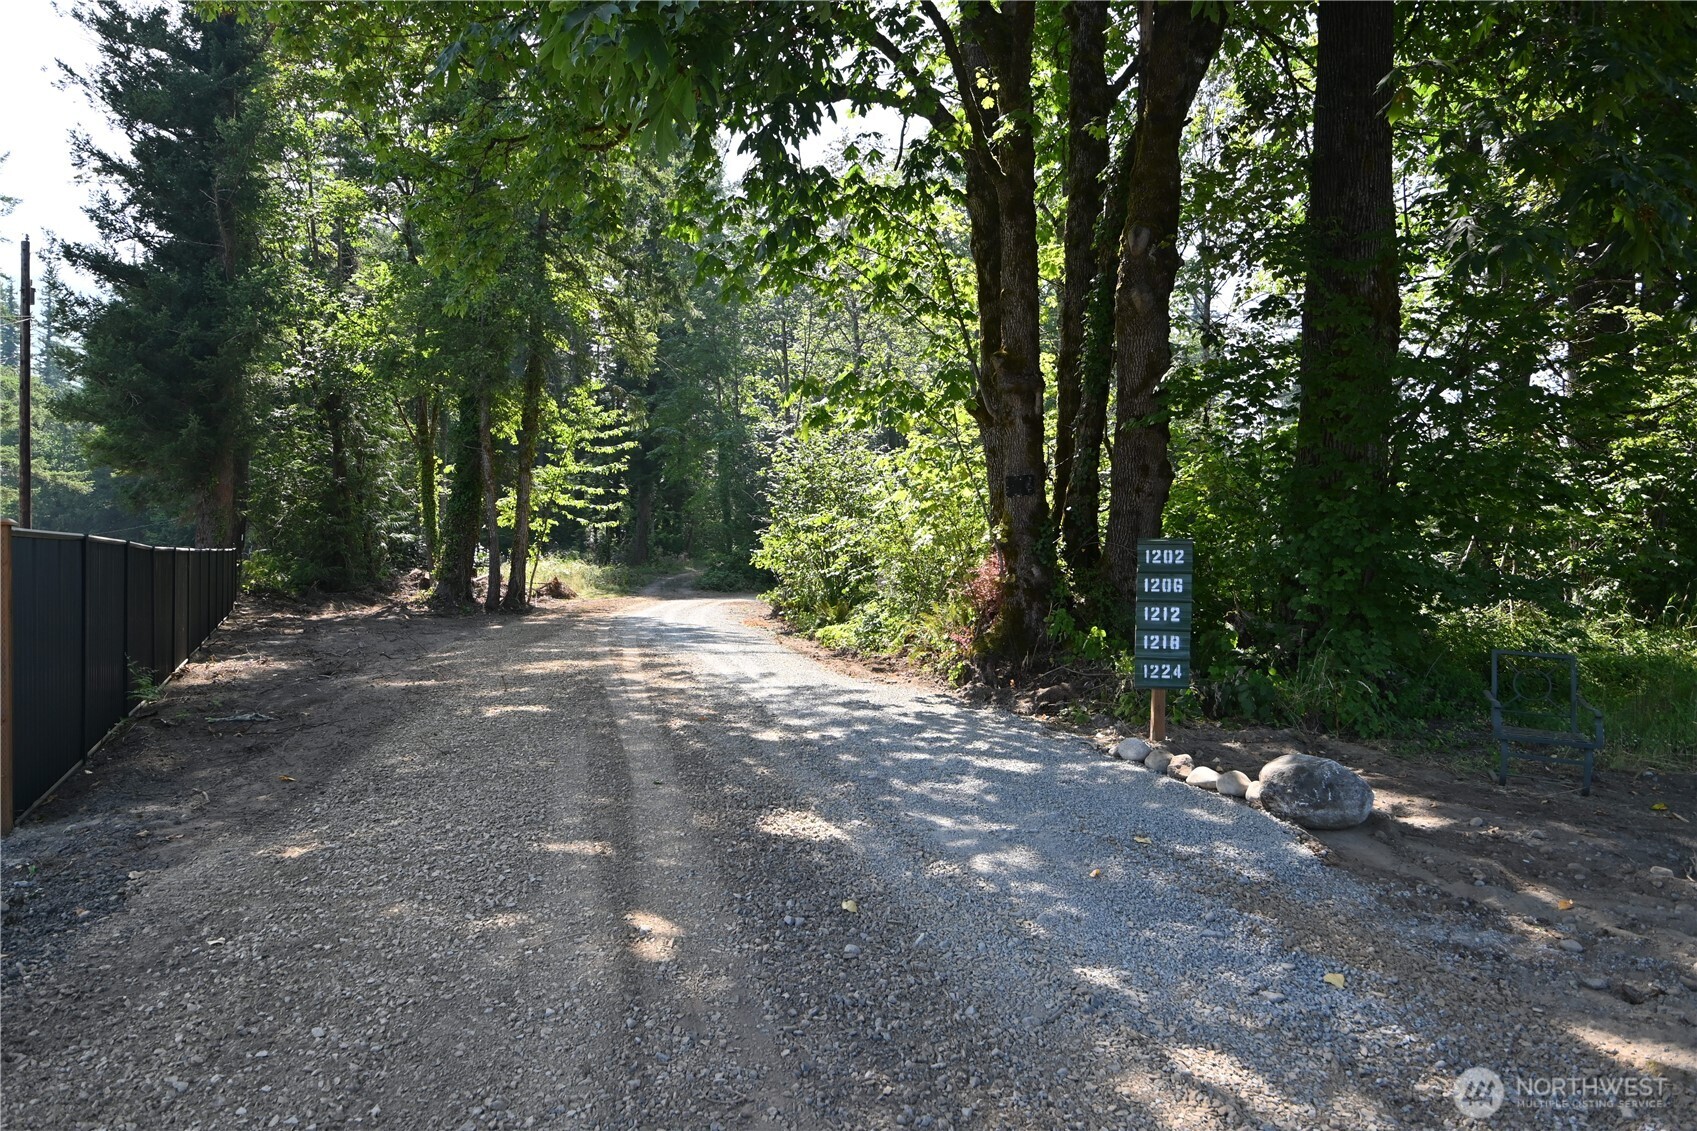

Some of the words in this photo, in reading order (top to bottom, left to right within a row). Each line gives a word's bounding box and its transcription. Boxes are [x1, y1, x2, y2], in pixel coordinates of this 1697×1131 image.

[1145, 549, 1185, 564] 1202
[1144, 578, 1183, 593] 1206
[1144, 606, 1180, 622] 1212
[1143, 635, 1180, 650] 1218
[1143, 664, 1182, 679] 1224
